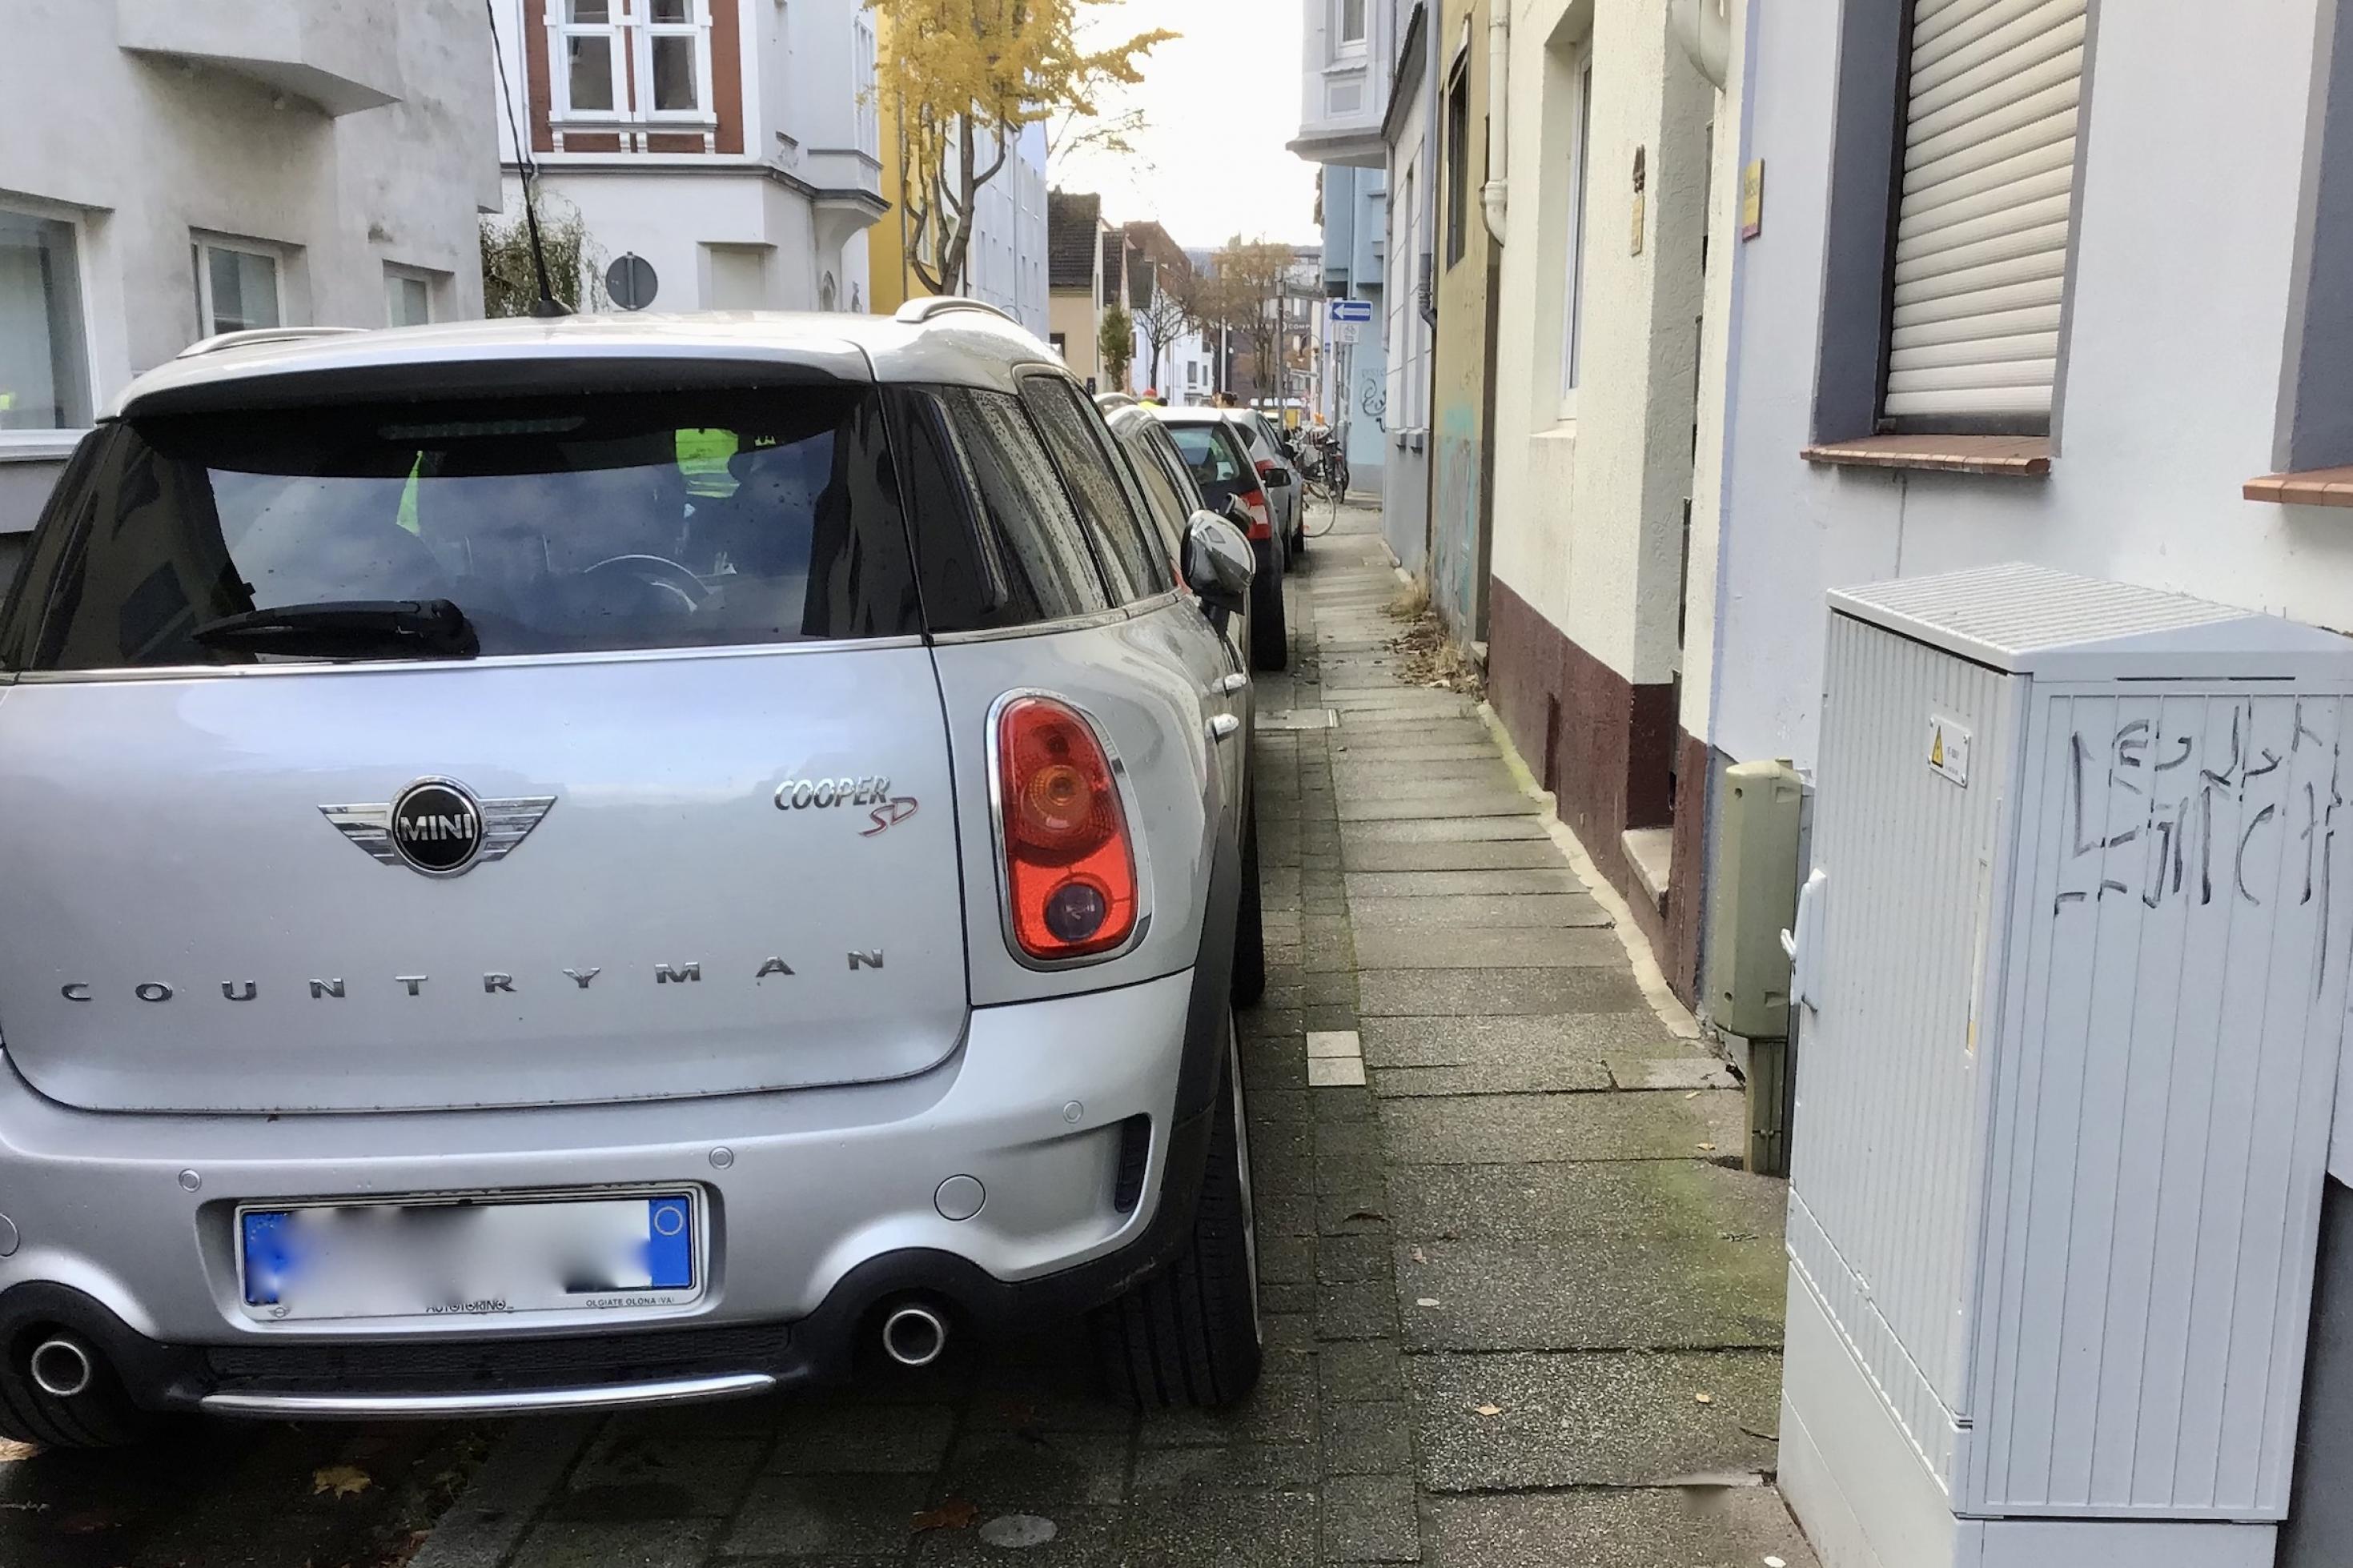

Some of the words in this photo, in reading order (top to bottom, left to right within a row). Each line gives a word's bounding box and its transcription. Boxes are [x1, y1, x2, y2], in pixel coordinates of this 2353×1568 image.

[774, 775, 890, 810] COOPER
[400, 814, 473, 841] MINI
[858, 797, 918, 837] SD
[61, 948, 883, 1002] COUNTRYMAN
[585, 1298, 623, 1307] OLGIATE
[625, 1297, 657, 1305] OLONA
